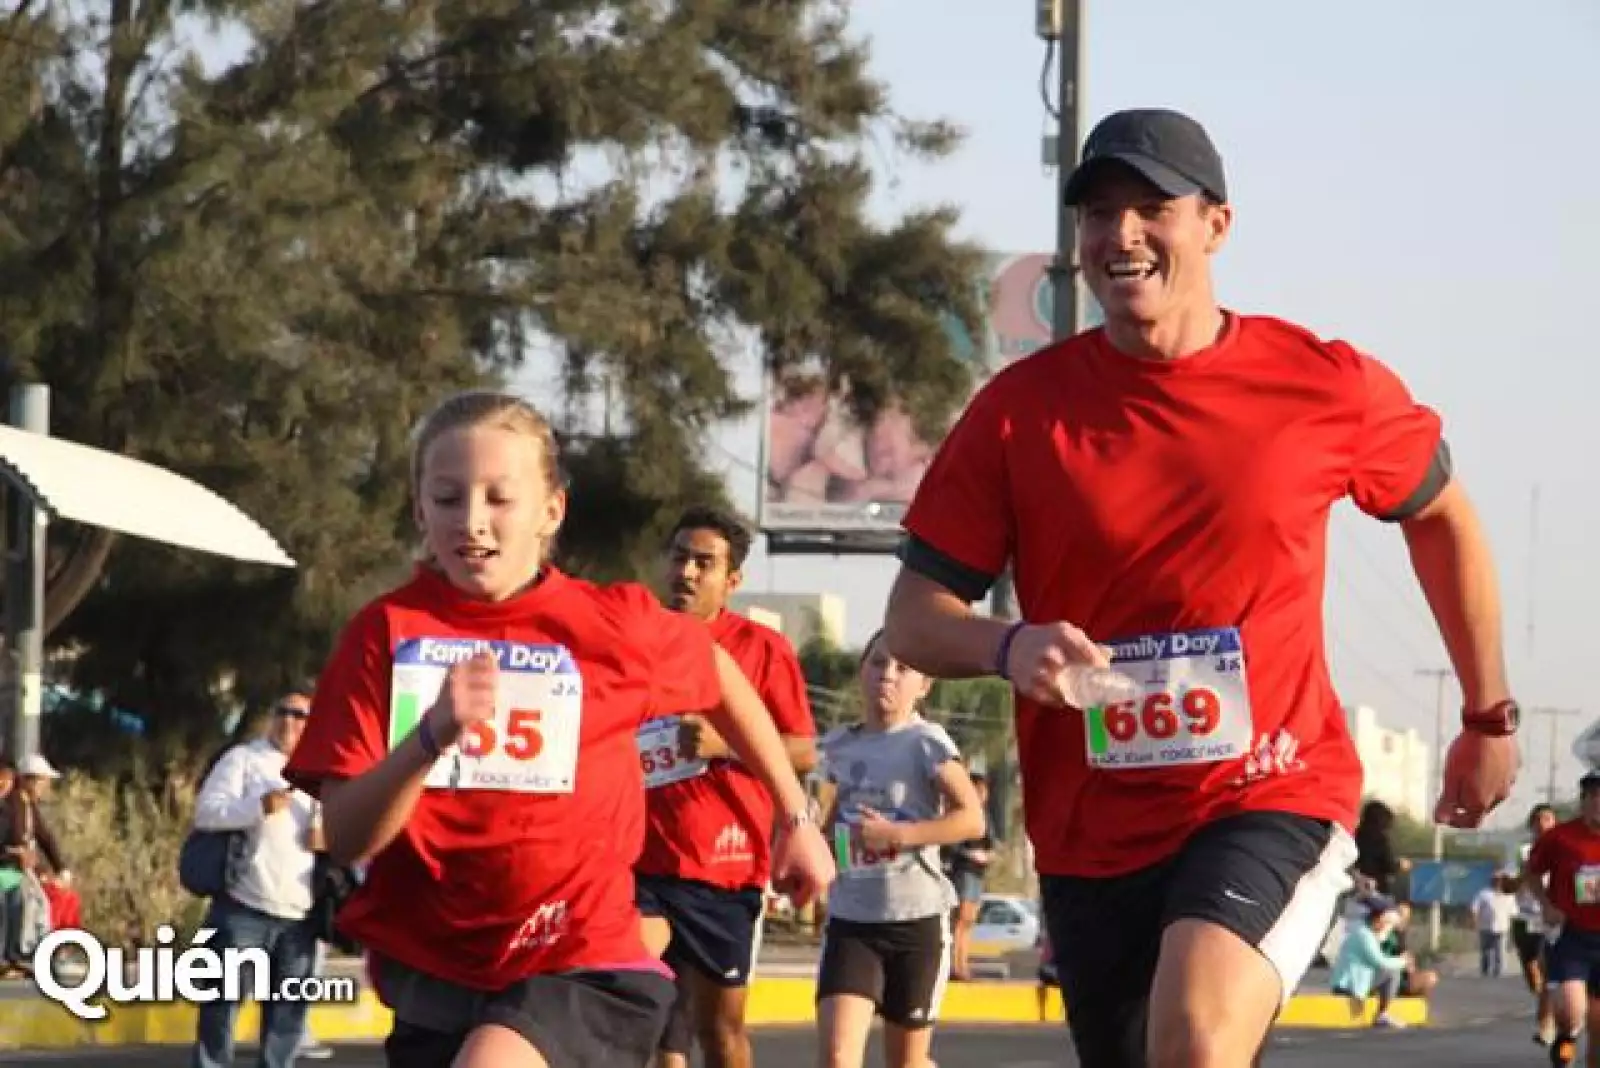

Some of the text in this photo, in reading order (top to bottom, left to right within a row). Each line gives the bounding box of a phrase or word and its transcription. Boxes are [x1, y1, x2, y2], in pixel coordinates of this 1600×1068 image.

[1171, 629, 1220, 656] Day
[509, 644, 563, 674] Day
[1104, 686, 1221, 742] 669
